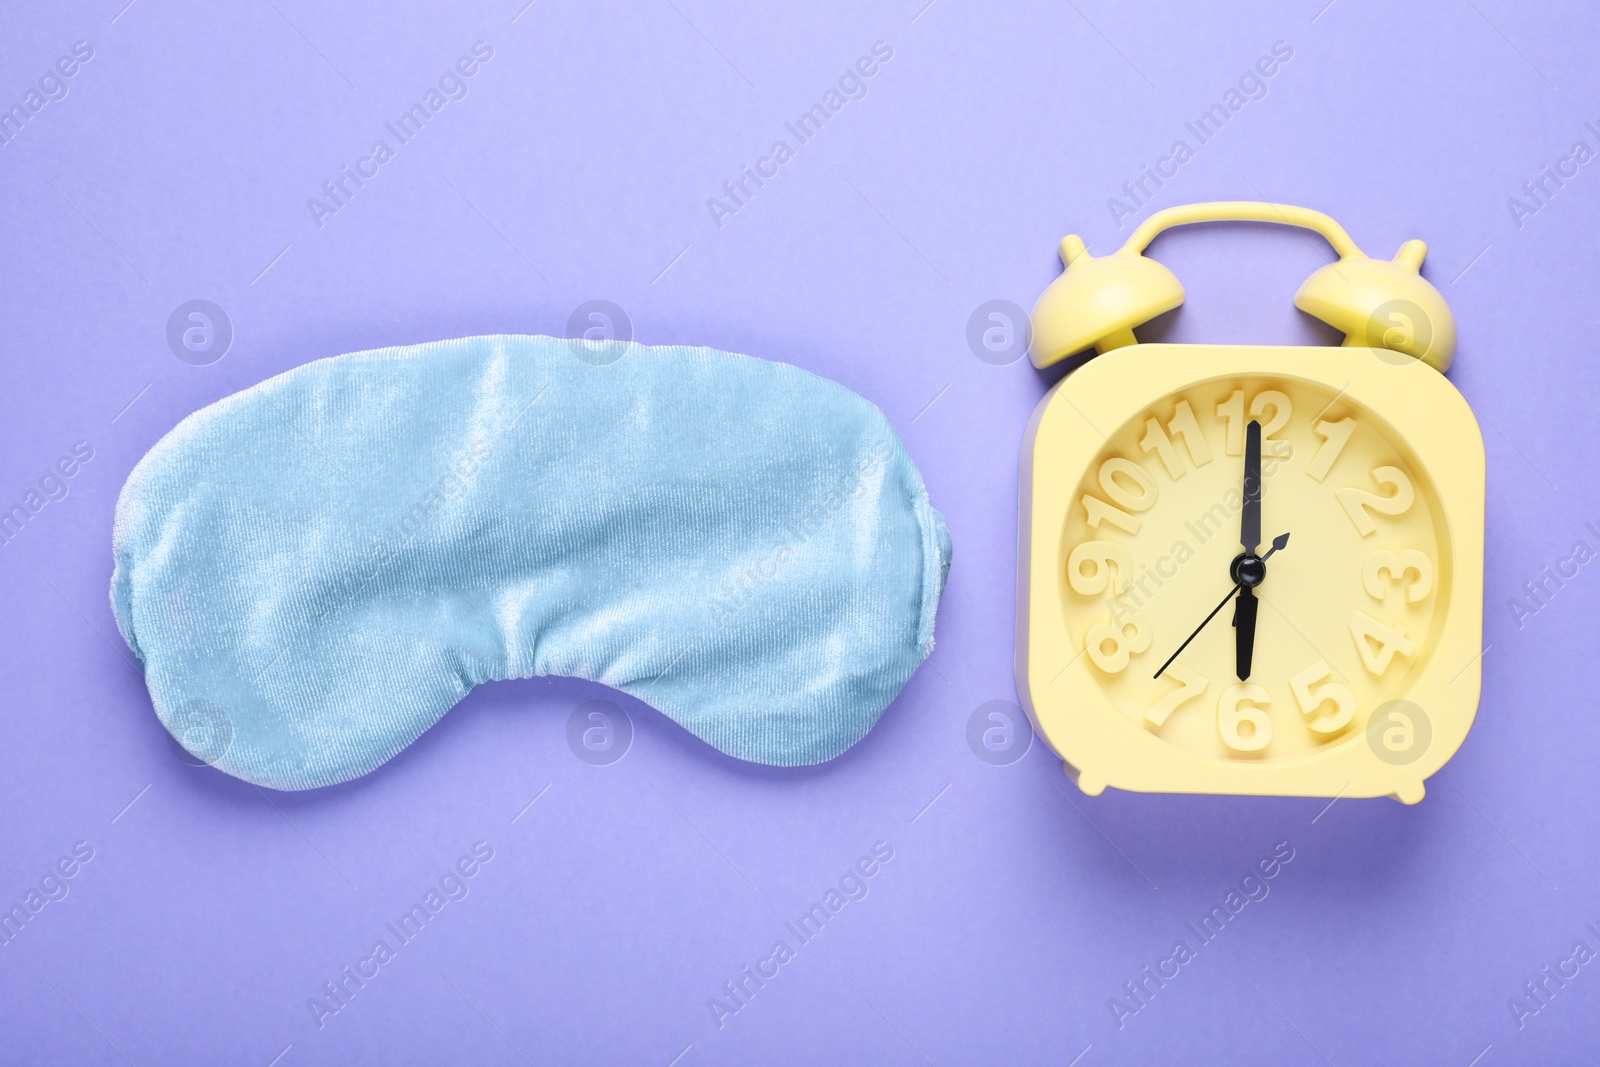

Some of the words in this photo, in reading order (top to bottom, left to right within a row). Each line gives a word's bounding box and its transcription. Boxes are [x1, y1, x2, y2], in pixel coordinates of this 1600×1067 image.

[1140, 399, 1214, 481] 11
[1216, 389, 1292, 458] 12
[1305, 416, 1357, 483] 1
[1080, 457, 1159, 536] 10
[1334, 465, 1415, 537] 2
[1068, 540, 1133, 596] 9
[1362, 549, 1433, 603] 3
[1085, 611, 1153, 674] 8
[1348, 610, 1416, 677] 4
[1143, 655, 1209, 727] 7
[1217, 683, 1273, 752] 6
[1288, 659, 1356, 734] 5
